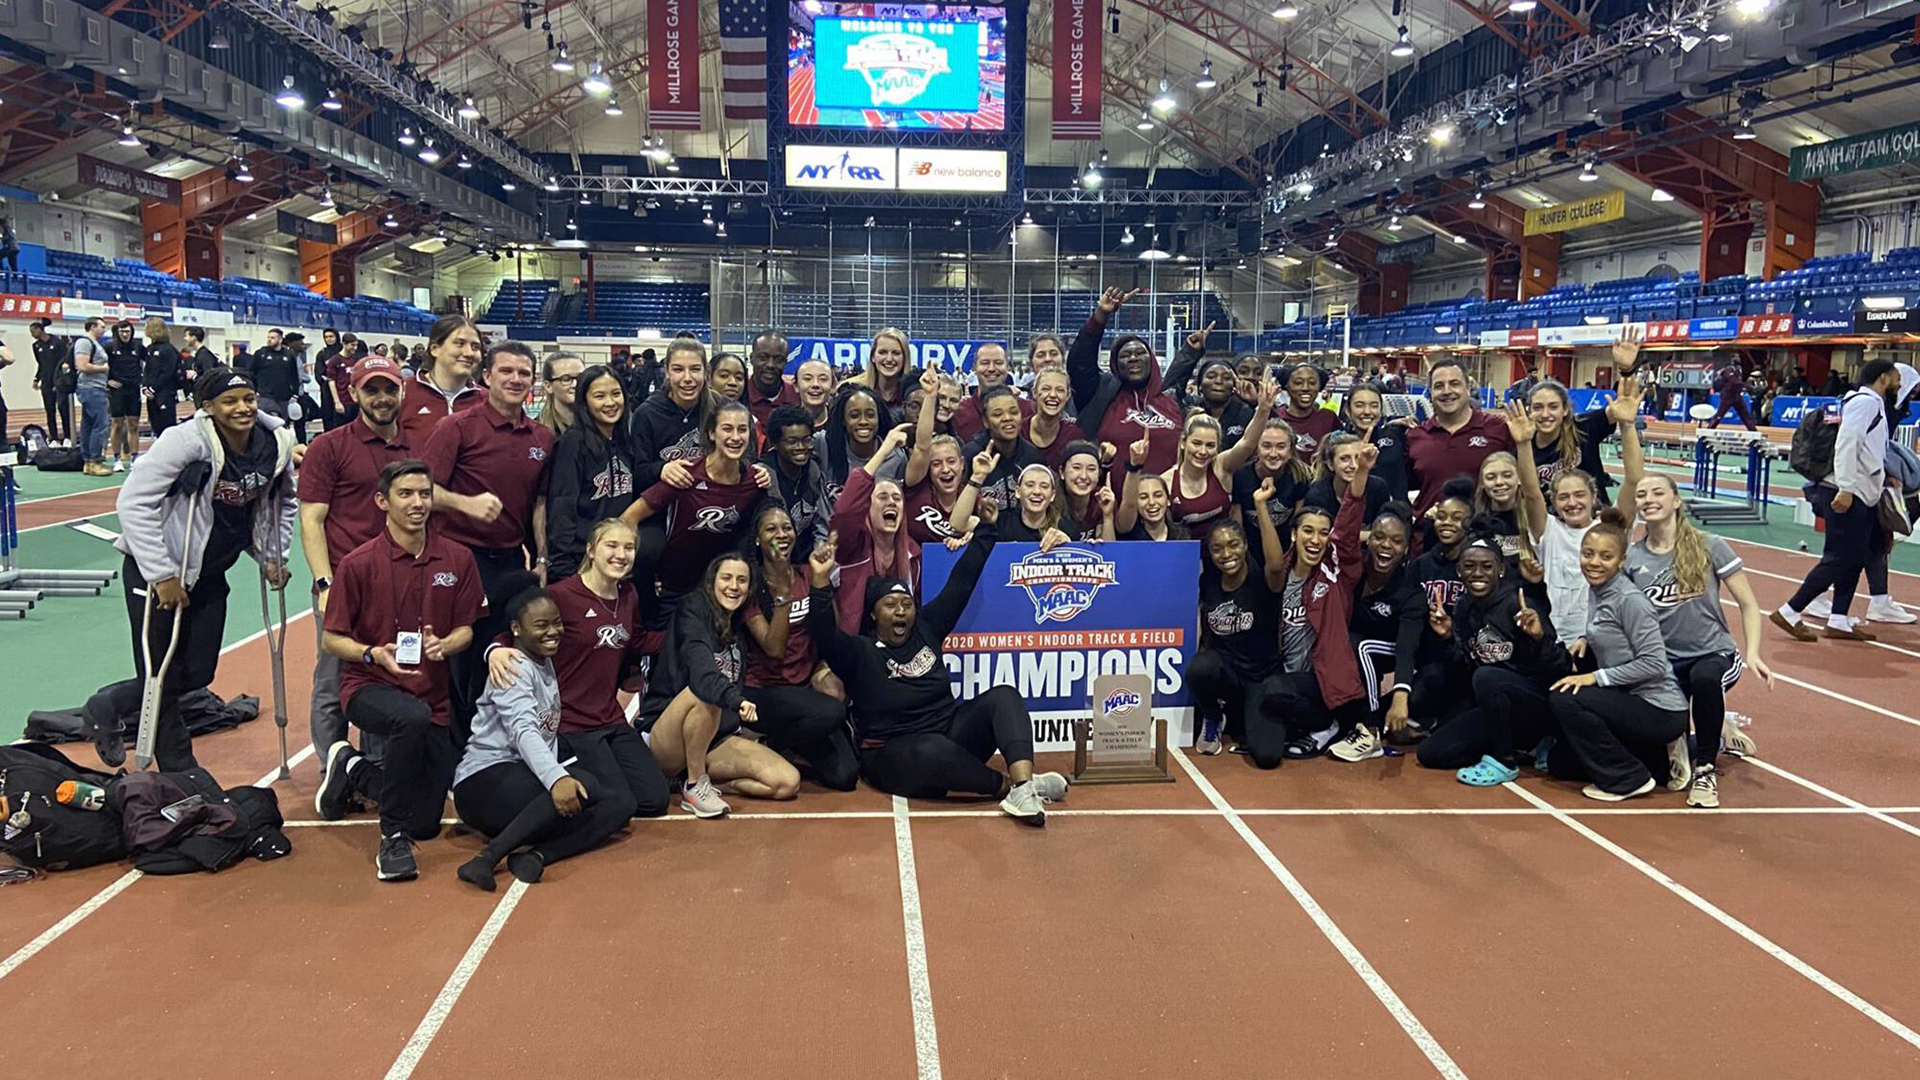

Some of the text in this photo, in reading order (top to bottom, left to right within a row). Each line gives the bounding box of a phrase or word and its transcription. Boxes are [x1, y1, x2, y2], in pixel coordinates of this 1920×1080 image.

[667, 30, 681, 104] MILLROSE
[1070, 43, 1084, 114] MILLROSE
[1805, 137, 1889, 171] MANHATTAN
[934, 167, 955, 177] new
[957, 166, 1002, 178] balance
[1540, 200, 1607, 225] HUNTER COLLEGE
[810, 342, 972, 375] ARORY
[1013, 564, 1113, 580] INDOOR TRACK
[1027, 576, 1098, 585] CHAMPIONSHIPS
[1037, 590, 1088, 618] MAAC
[944, 631, 1175, 649] 2020 WOMEN'S INDOOR TRACK & FIELD
[942, 647, 1184, 700] CHAMPIONS
[1103, 694, 1140, 714] MAAC
